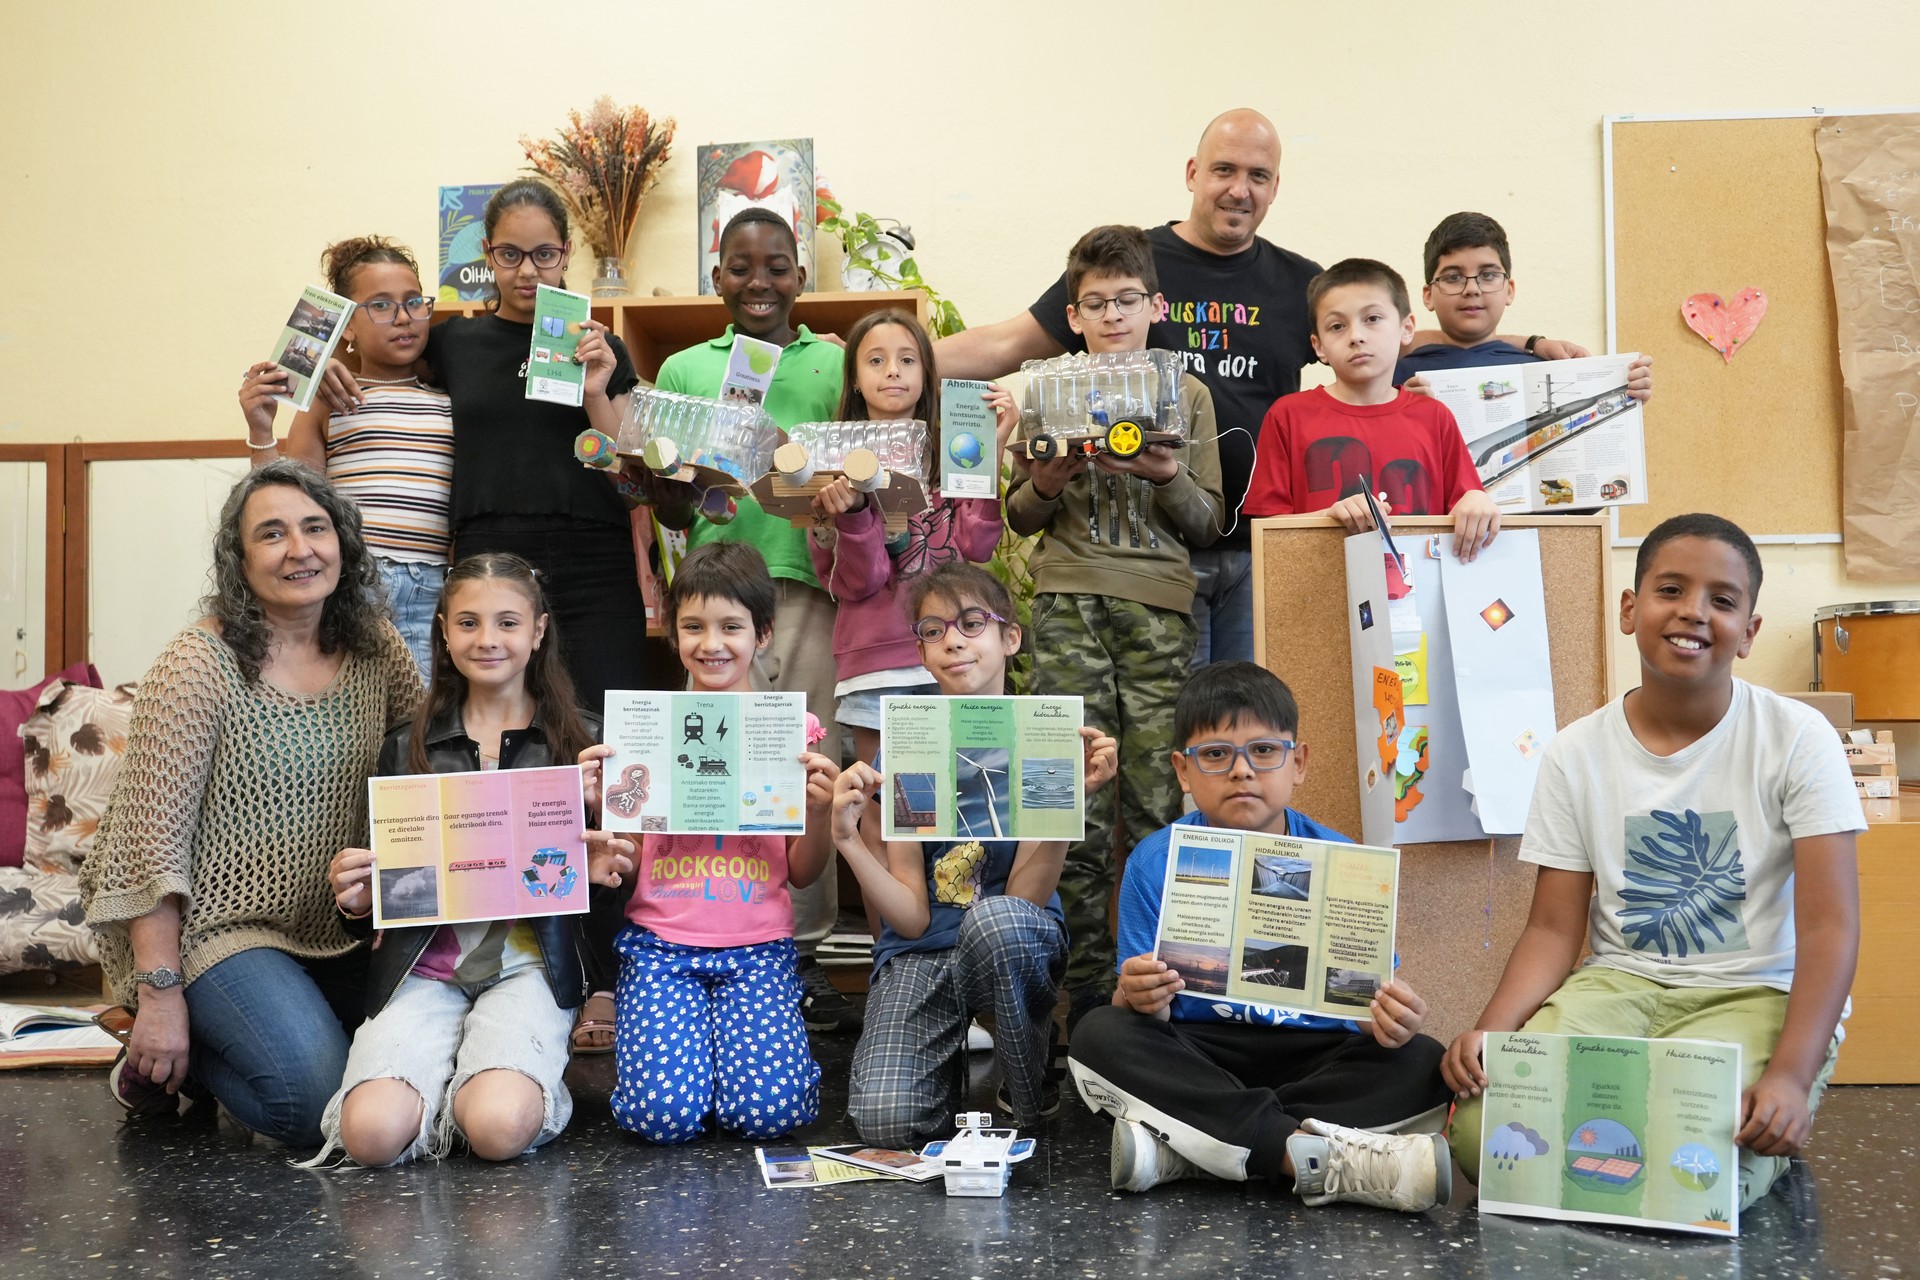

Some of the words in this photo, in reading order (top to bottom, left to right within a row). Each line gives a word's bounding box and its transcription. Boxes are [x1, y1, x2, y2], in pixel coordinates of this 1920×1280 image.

[1188, 326, 1229, 350] bizi
[547, 369, 562, 377] LH4
[736, 371, 760, 383] Greatness
[956, 403, 980, 411] Energia
[950, 411, 986, 419] kontsumoa
[889, 702, 912, 712] Eguzki
[1274, 841, 1303, 849] ENERGIA
[1255, 847, 1300, 857] HIDRAULIKOA
[651, 856, 770, 882] ROCKGOOD
[646, 884, 702, 898] Princess
[673, 882, 704, 890] missgirl
[704, 878, 767, 904] LOVE
[1248, 907, 1292, 917] mugimenduarekin
[1509, 1035, 1541, 1046] Energia
[1501, 1044, 1548, 1056] hidraulikoa
[1576, 1042, 1606, 1054] Eguzki
[1607, 1047, 1640, 1057] energia
[1665, 1049, 1692, 1059] Haize
[1693, 1054, 1727, 1065] energia
[1503, 1083, 1548, 1092] mugimenduak
[1528, 1094, 1552, 1103] energia
[1681, 1101, 1709, 1110] lortzeko
[1677, 1113, 1712, 1122] erabiltzen
